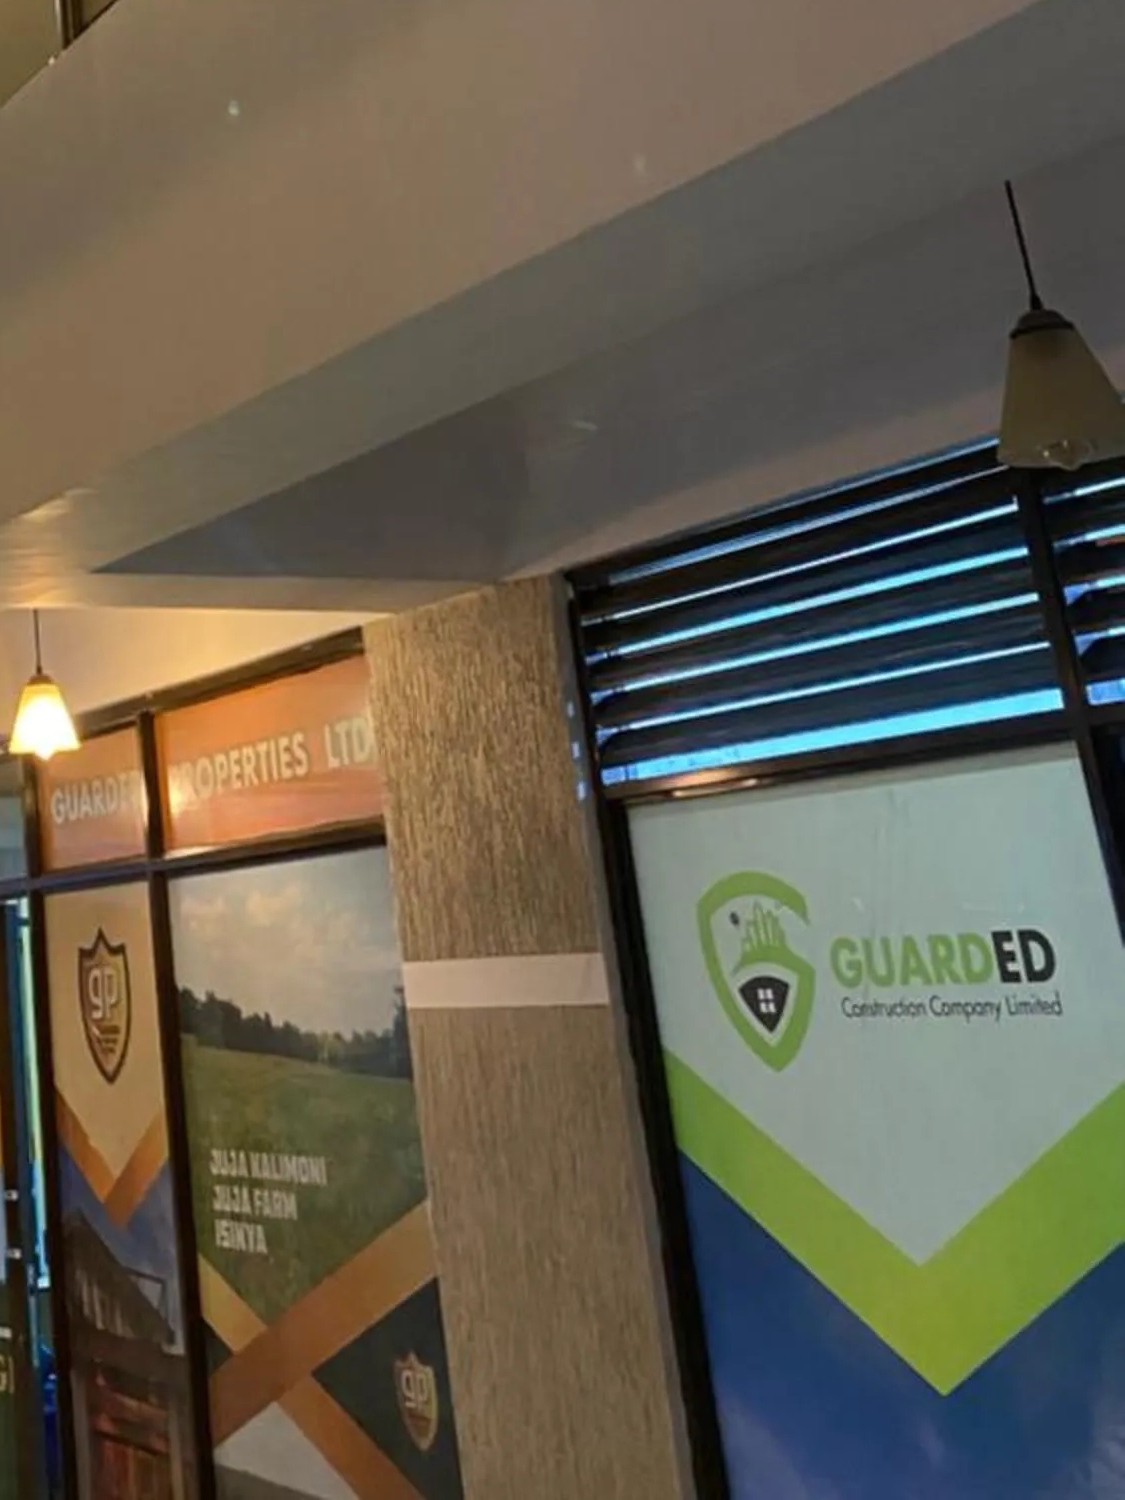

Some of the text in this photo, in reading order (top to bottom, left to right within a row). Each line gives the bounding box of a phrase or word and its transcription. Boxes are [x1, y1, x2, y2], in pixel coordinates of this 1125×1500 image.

[324, 717, 373, 769] LTD
[829, 929, 1057, 988] GUARDED
[840, 989, 1063, 1023] Construction Company Limited
[253, 1188, 298, 1220] FARM
